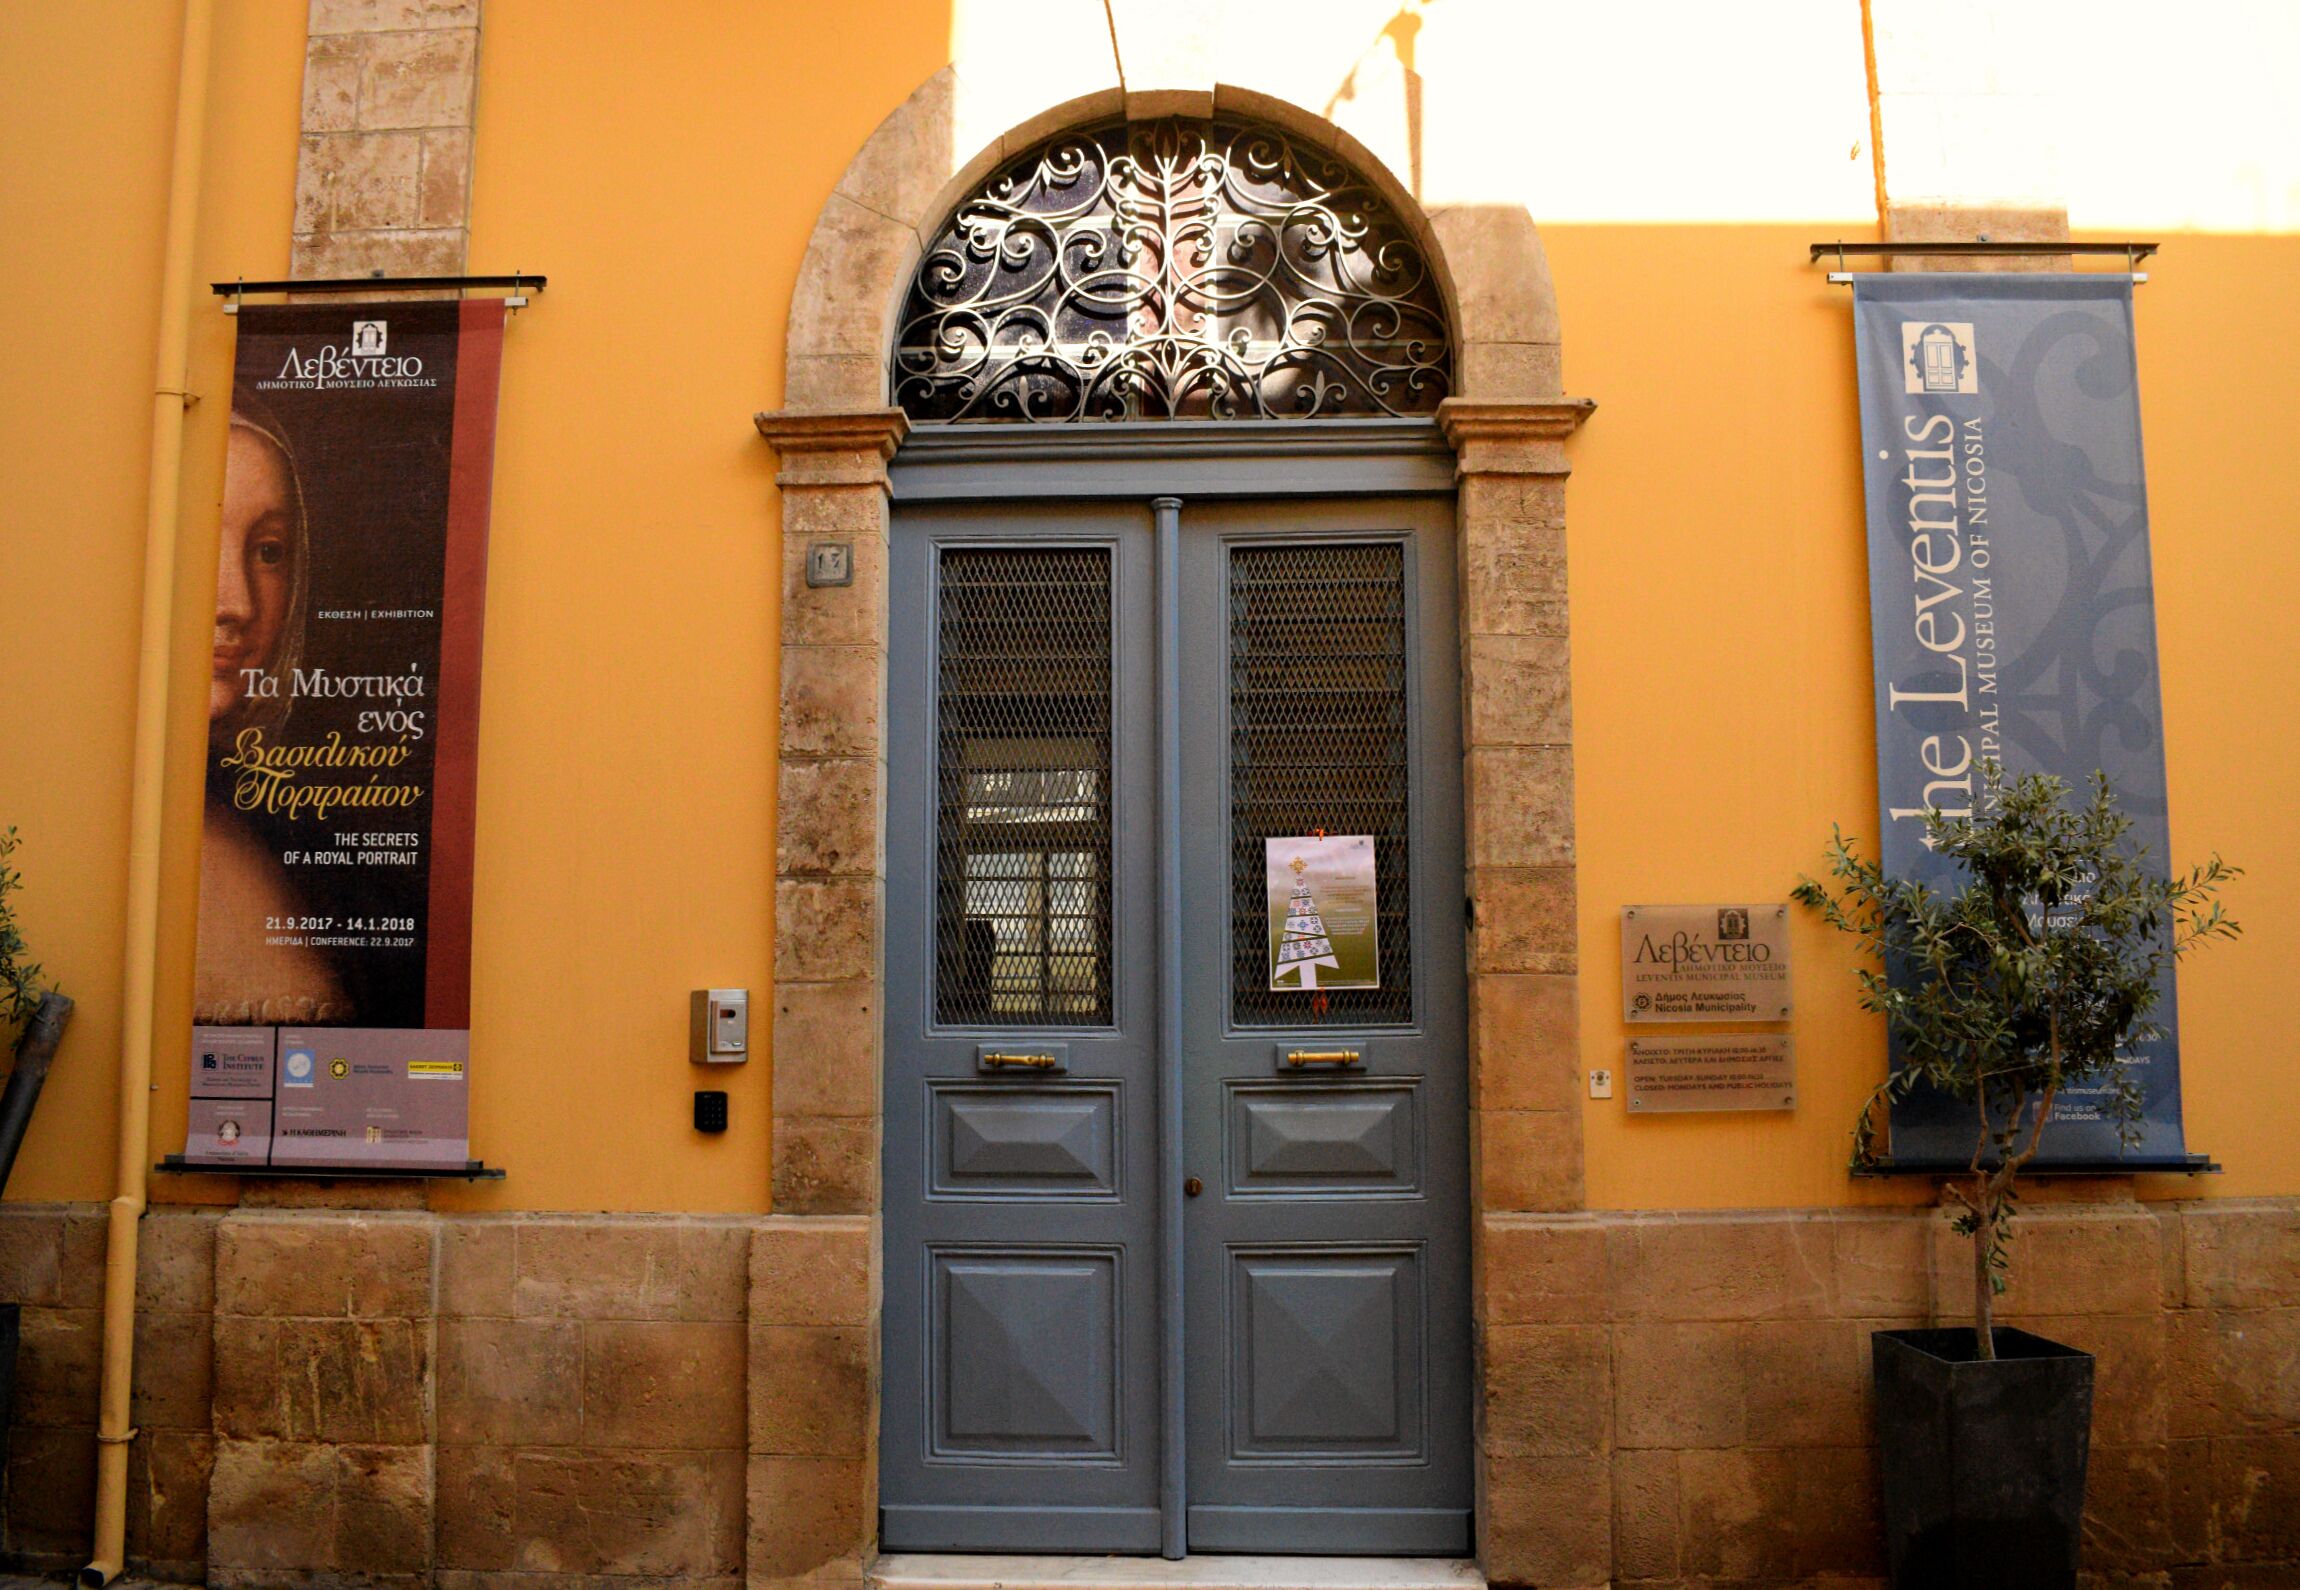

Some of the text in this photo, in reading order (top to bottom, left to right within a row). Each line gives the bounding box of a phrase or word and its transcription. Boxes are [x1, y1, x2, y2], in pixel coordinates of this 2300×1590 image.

[277, 345, 423, 390] Λεβέντειο
[256, 378, 437, 390] ΔΗΜΟΤΙΚΟ ΜΟΥΣΕΙΟ ΛΕΥΚΩΣΙΑΣ
[1964, 416, 1988, 525] NICOSIA
[1970, 534, 1991, 569] OF
[1879, 414, 1968, 712] Leventis
[318, 611, 361, 620] ΕΚΘΕΣΗ
[371, 610, 434, 619] EXHIBITION
[1972, 577, 1997, 694] MUSEUM
[240, 662, 425, 698] Τα Μυστικά
[357, 698, 425, 740] ενός
[220, 727, 412, 772] Βασιλικού
[234, 766, 424, 820] Πορτραίτου
[334, 832, 419, 846] THE SECRETS
[283, 851, 418, 865] OF A ROYAL PORTRAIT
[265, 916, 333, 930] 21.9.2017
[346, 917, 415, 931] 14.1.2018
[265, 936, 303, 946] ΗΜΕΡΙΔΑ
[310, 936, 414, 947] CONFERENCE: 22.9.2017
[1634, 931, 1770, 973] Λεβέντειο
[1636, 972, 1786, 982] LEVENTIS MUNICIPAL MUSEUM
[1655, 991, 1746, 1002] Δήμος Λευκωσίας
[1655, 1003, 1756, 1013] Nicosia Municipality
[2054, 1103, 2072, 1112] Find
[2054, 1112, 2102, 1121] Facebook
